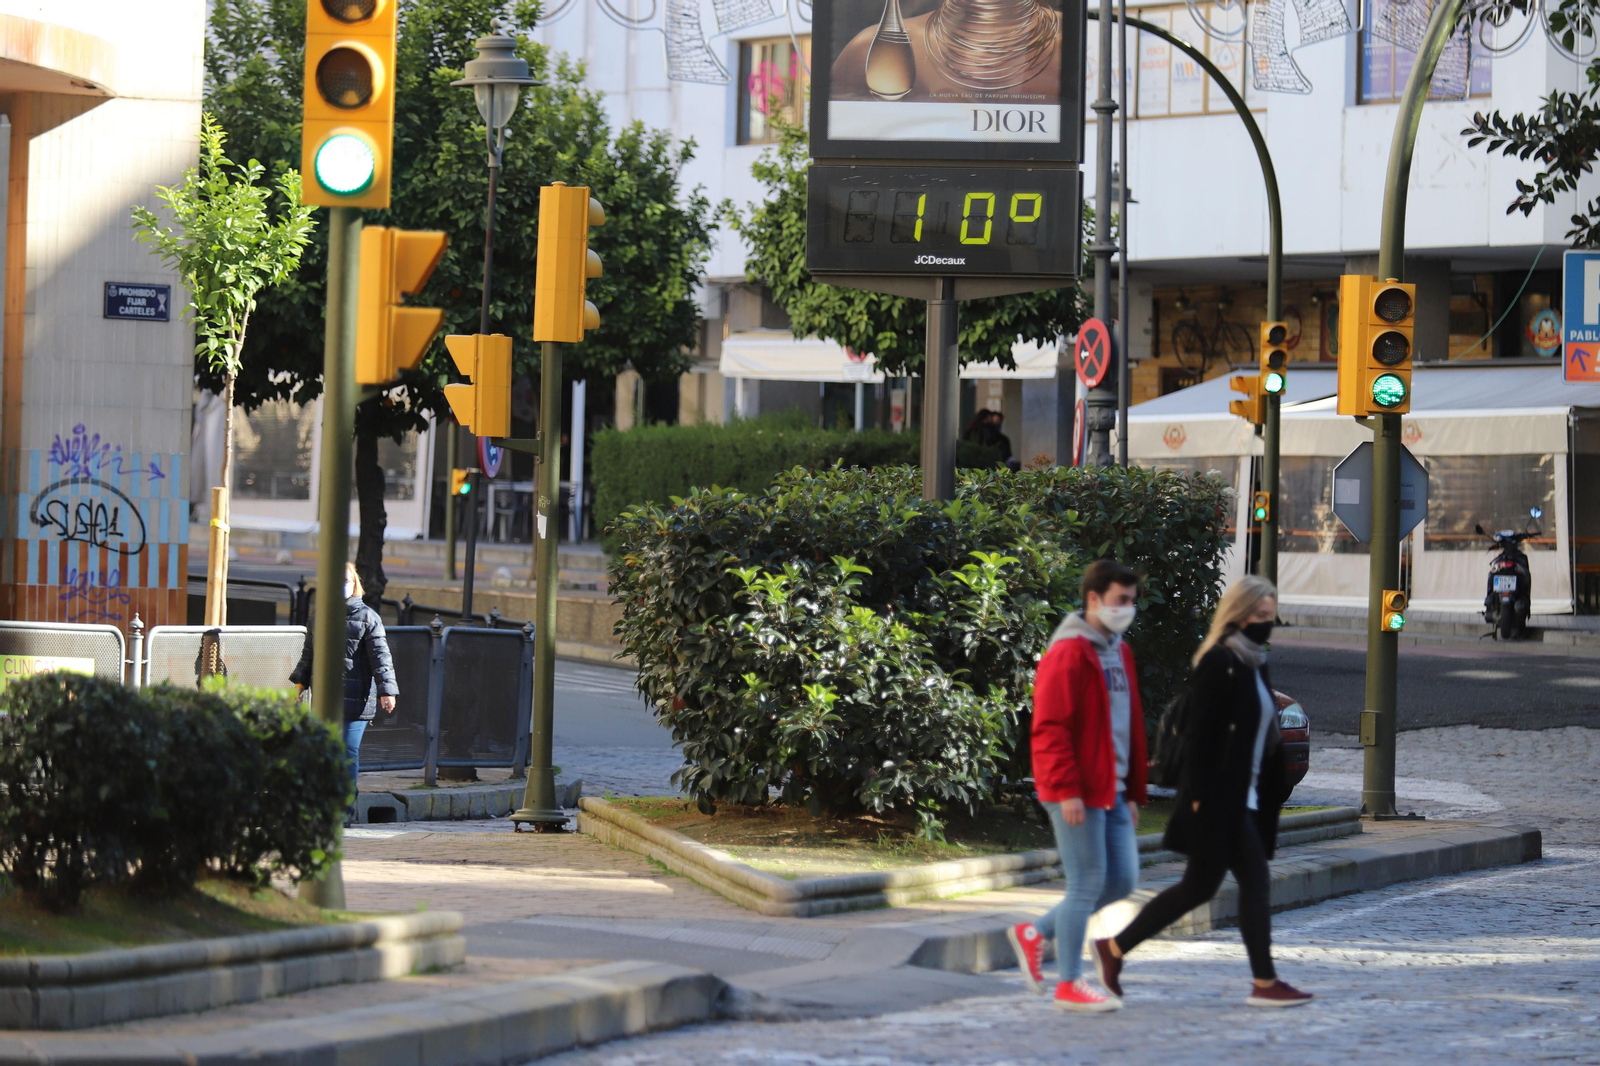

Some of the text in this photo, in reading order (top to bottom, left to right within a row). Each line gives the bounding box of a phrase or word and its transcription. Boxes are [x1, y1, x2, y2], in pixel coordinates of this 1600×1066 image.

[971, 109, 1048, 133] DIOR
[914, 255, 966, 265] JCDecaux
[118, 288, 156, 297] PROHIBIDO
[119, 306, 155, 315] CARTELES
[1570, 330, 1600, 341] PABL
